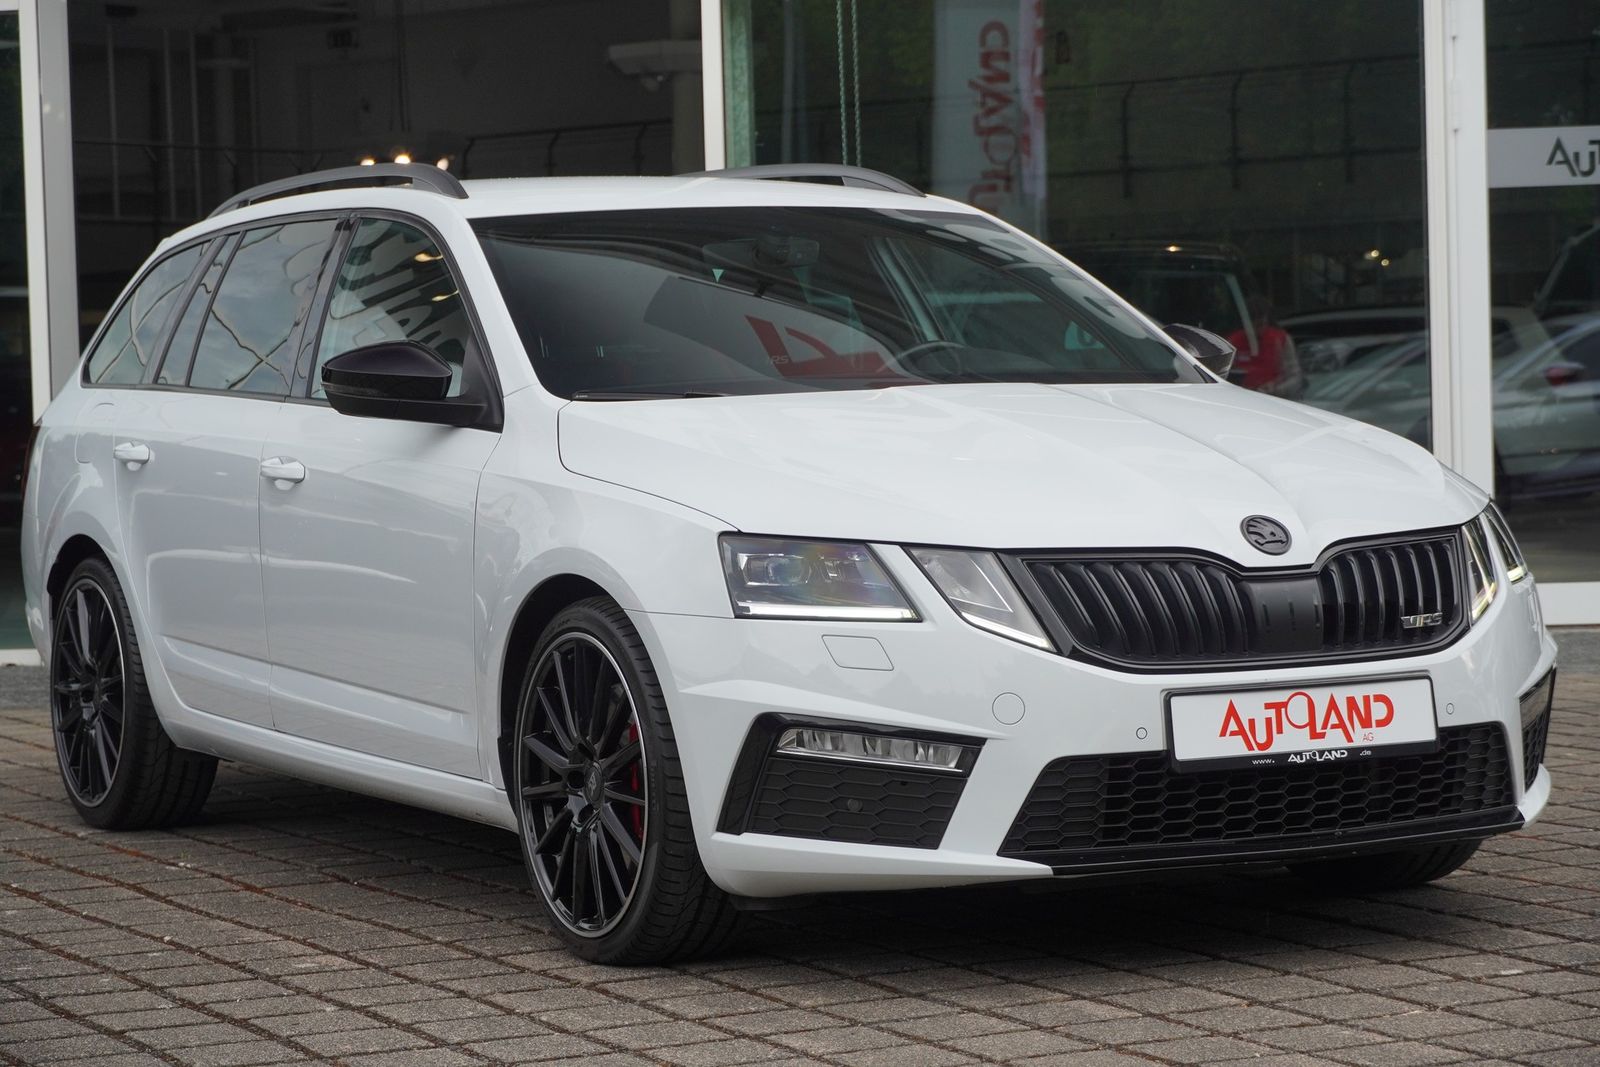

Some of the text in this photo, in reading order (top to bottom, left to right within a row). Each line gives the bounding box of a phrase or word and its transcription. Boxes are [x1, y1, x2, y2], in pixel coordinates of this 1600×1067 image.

[1219, 691, 1394, 751] AUTOLAND
[1362, 732, 1374, 742] AG
[1287, 749, 1348, 763] AUTOLAND
